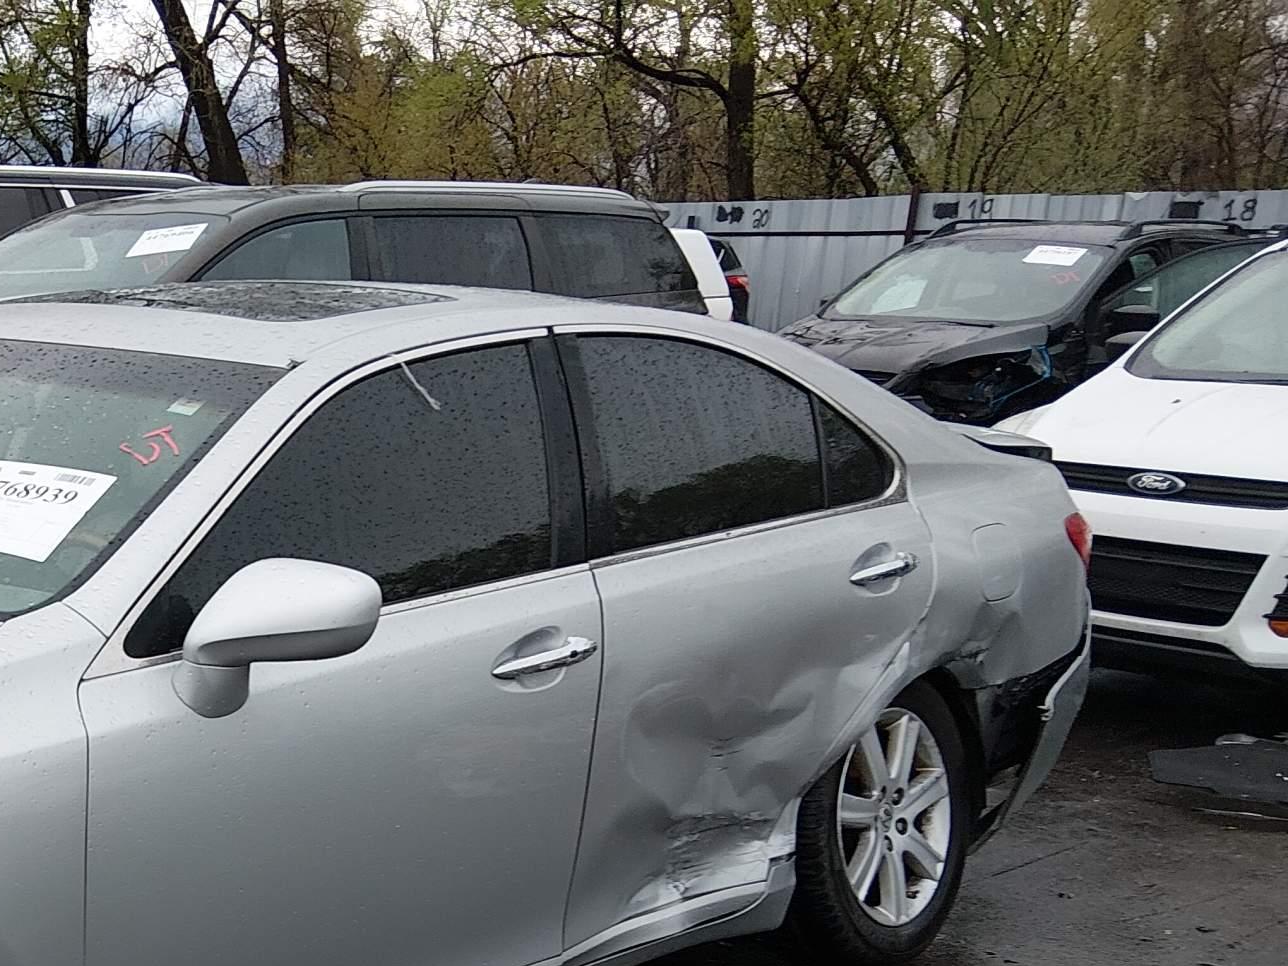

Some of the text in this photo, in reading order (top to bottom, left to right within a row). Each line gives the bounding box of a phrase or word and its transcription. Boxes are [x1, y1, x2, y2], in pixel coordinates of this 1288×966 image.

[752, 208, 770, 229] 20
[968, 197, 994, 219] 19
[1222, 197, 1258, 222] 18
[1135, 475, 1173, 490] Ford
